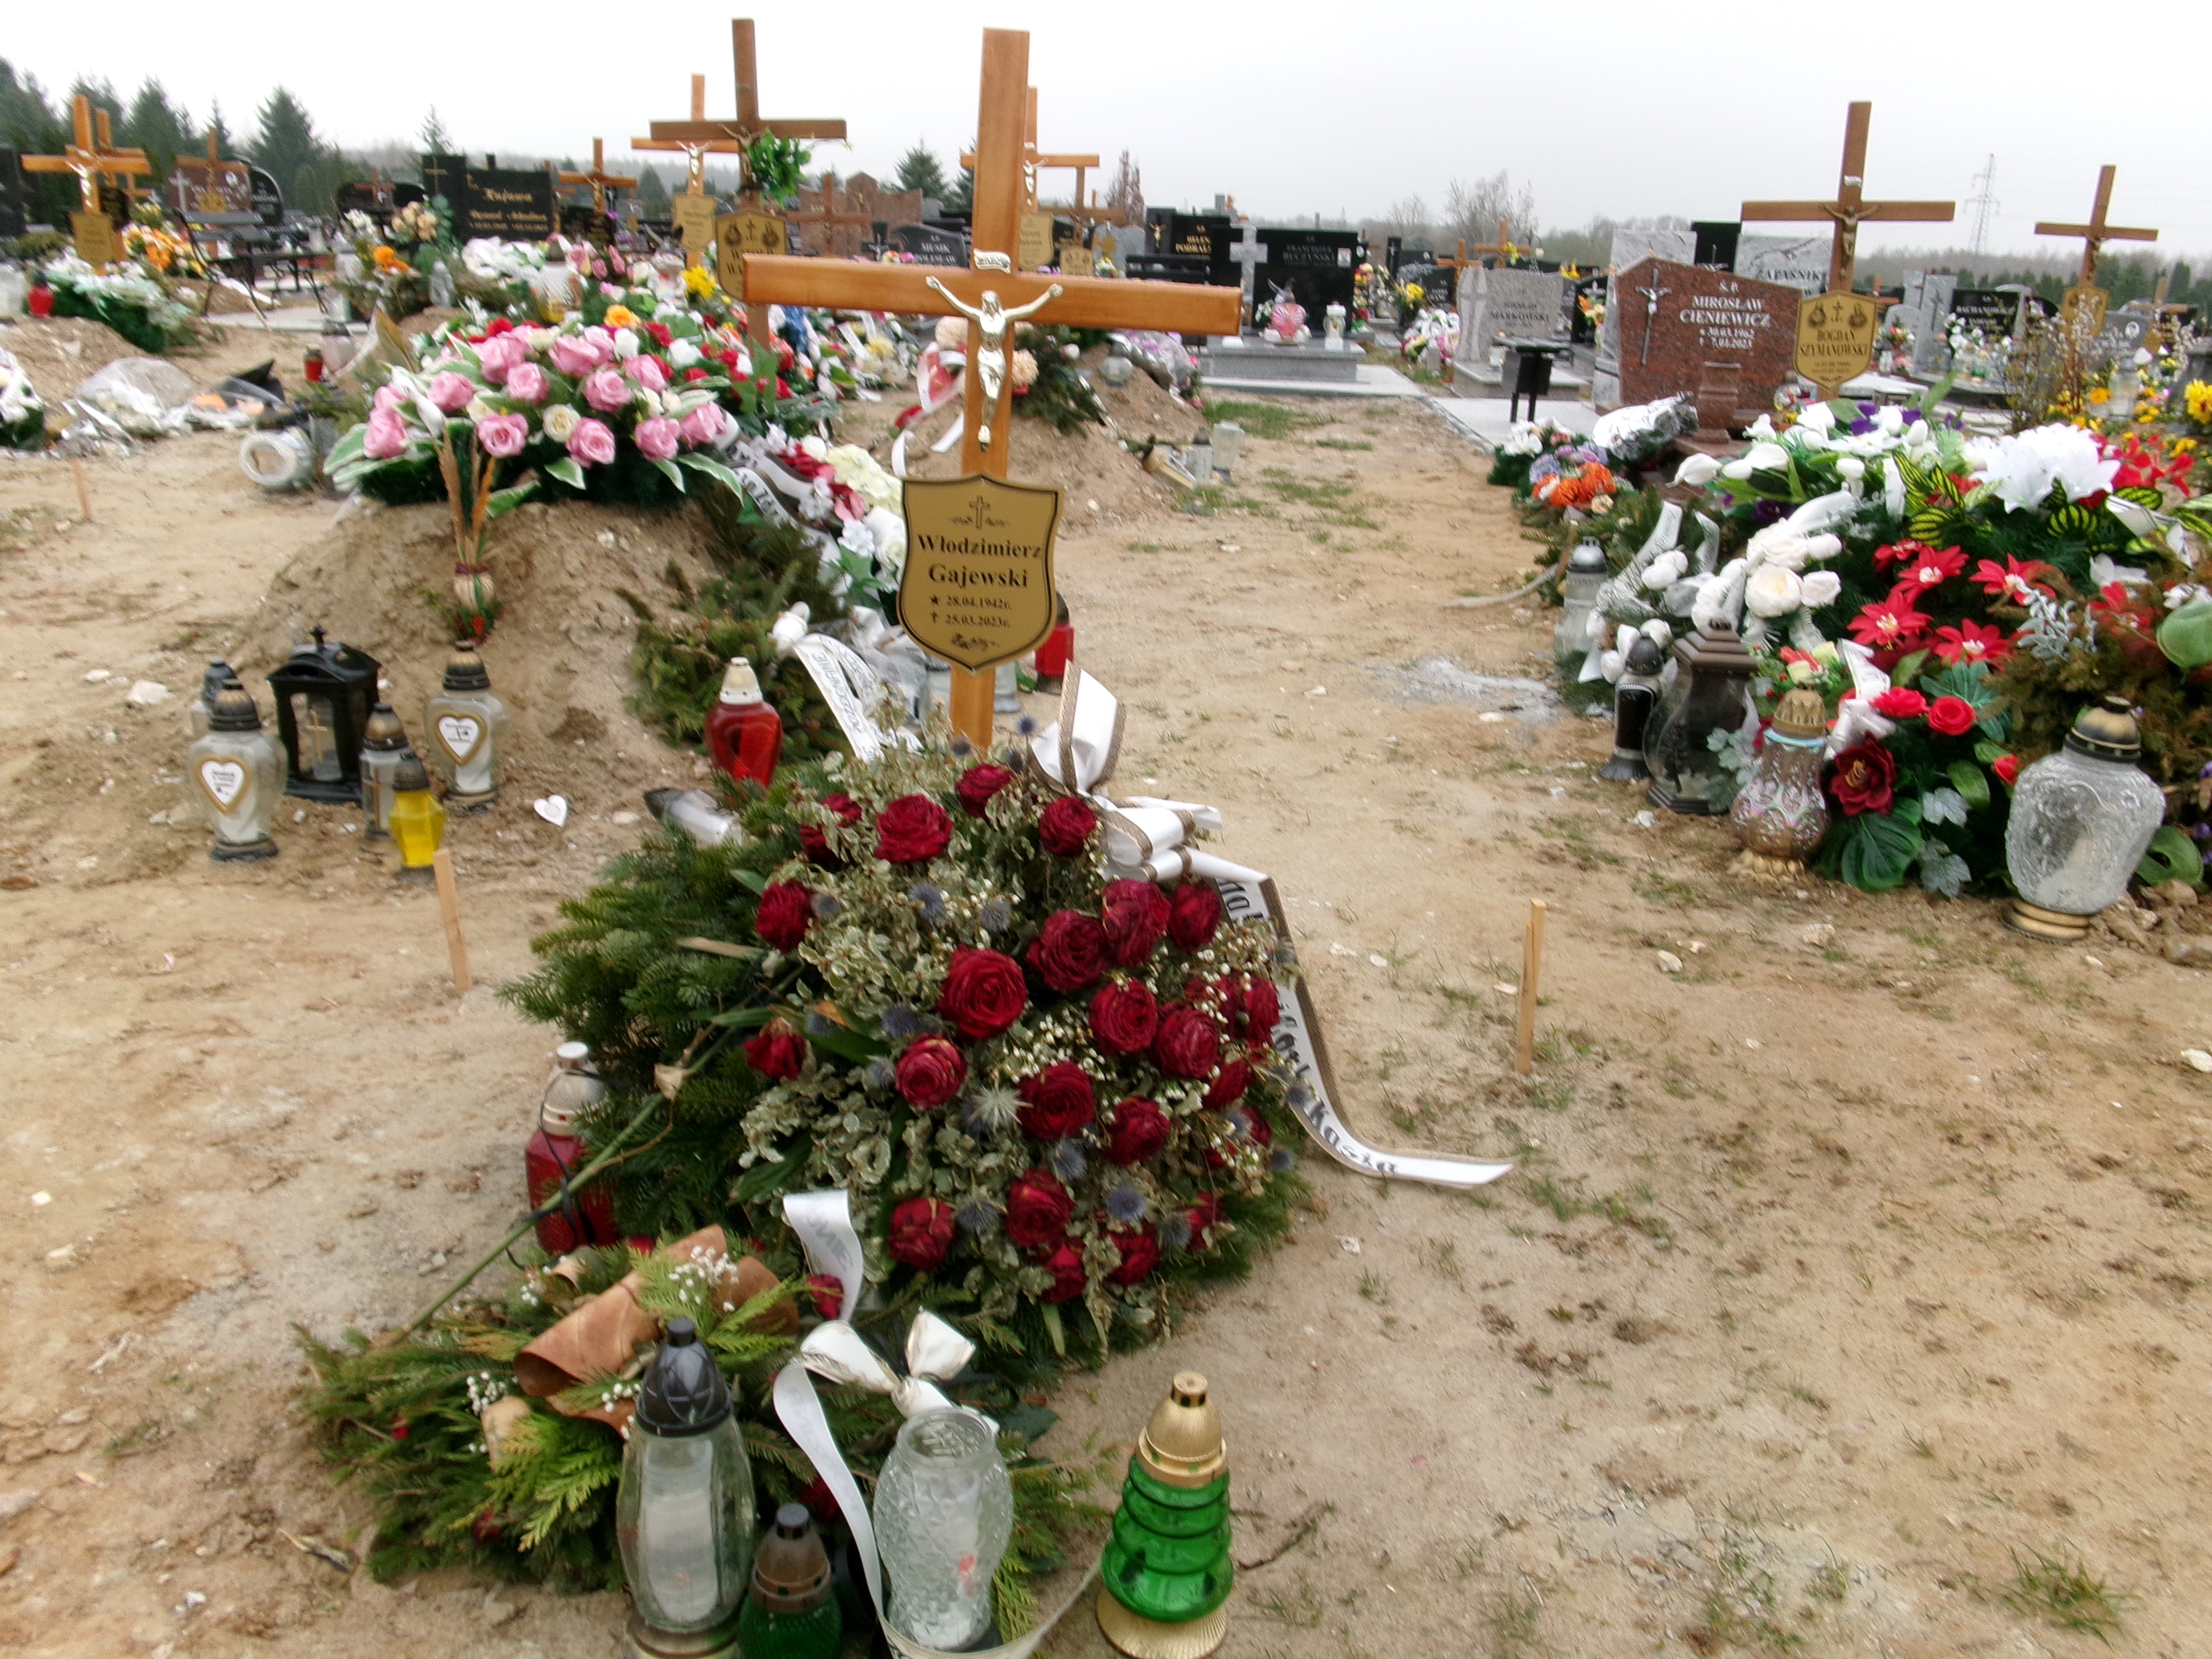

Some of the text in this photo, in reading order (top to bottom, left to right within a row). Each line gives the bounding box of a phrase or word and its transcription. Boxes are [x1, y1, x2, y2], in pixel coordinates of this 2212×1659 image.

[1692, 295, 1765, 312] MIROSŁAW
[1679, 309, 1771, 327] CIENIEWICZ
[1817, 329, 1855, 341] BOGDAN
[1800, 343, 1868, 356] SZYMANOWSKI
[917, 534, 1041, 558] Włodzimierz
[928, 562, 1028, 589] Gajewski
